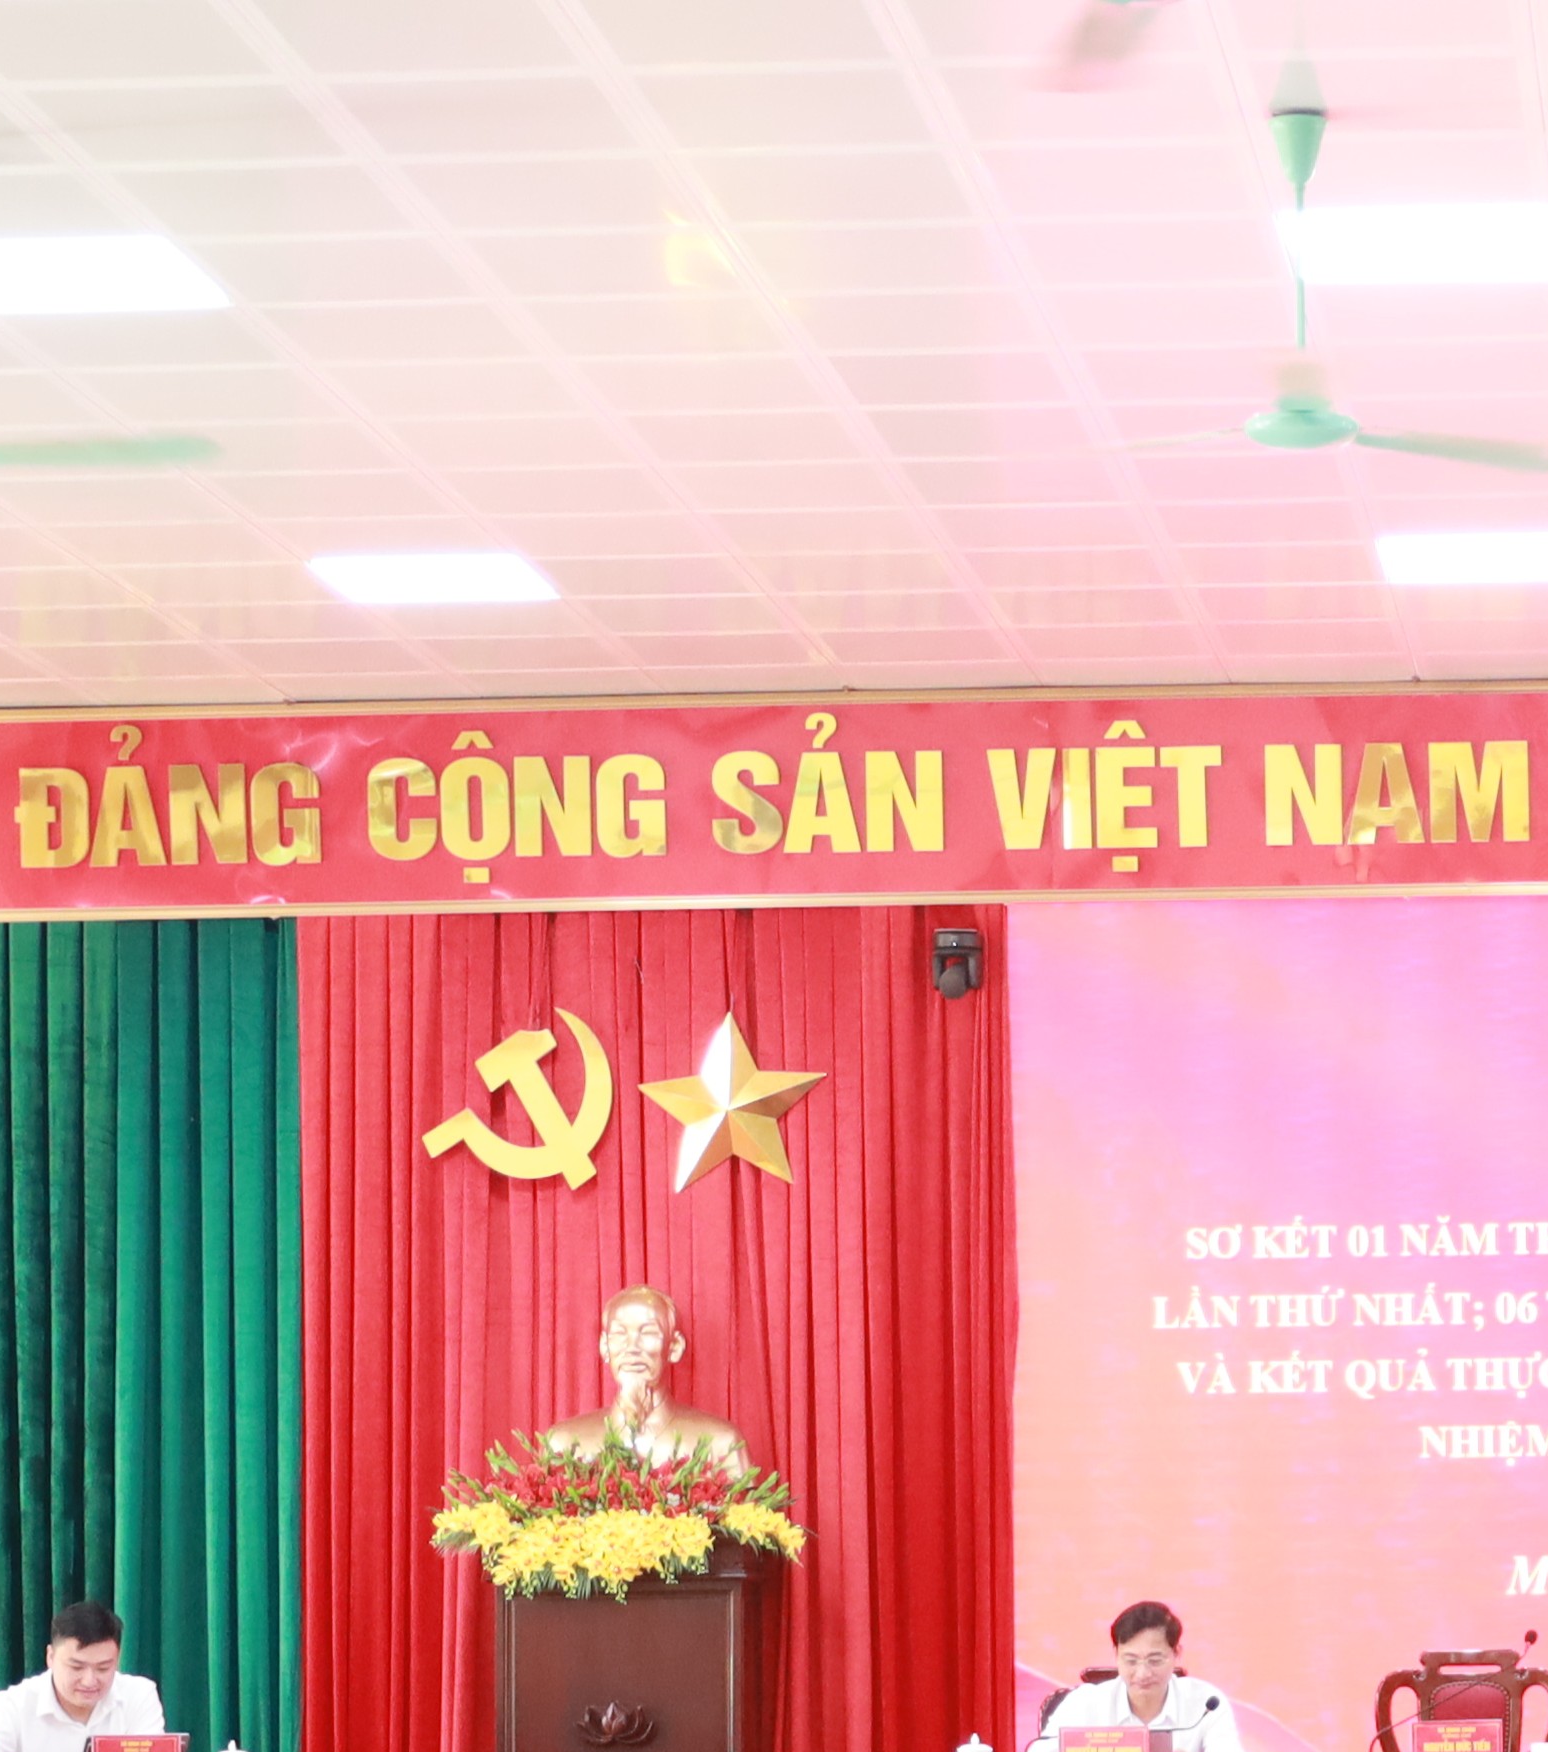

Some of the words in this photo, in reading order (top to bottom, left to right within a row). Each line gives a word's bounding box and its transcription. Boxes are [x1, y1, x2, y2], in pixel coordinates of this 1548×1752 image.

[14, 724, 322, 868] ĐẢNG
[368, 731, 666, 883] CỘNG
[713, 713, 945, 853] SẢN
[987, 720, 1218, 871] VIỆT
[1265, 741, 1530, 845] NAM
[1185, 1223, 1243, 1260] SƠ
[1251, 1215, 1337, 1259] KẾT
[1347, 1225, 1388, 1258] 01
[1399, 1215, 1500, 1257] NĂM
[1152, 1285, 1241, 1330] LẦN
[1249, 1285, 1346, 1328] THỨ
[1494, 1291, 1538, 1324] 06
[1176, 1351, 1237, 1395] VÀ
[1248, 1349, 1334, 1394] KẾT
[1344, 1347, 1437, 1400] QUẢ
